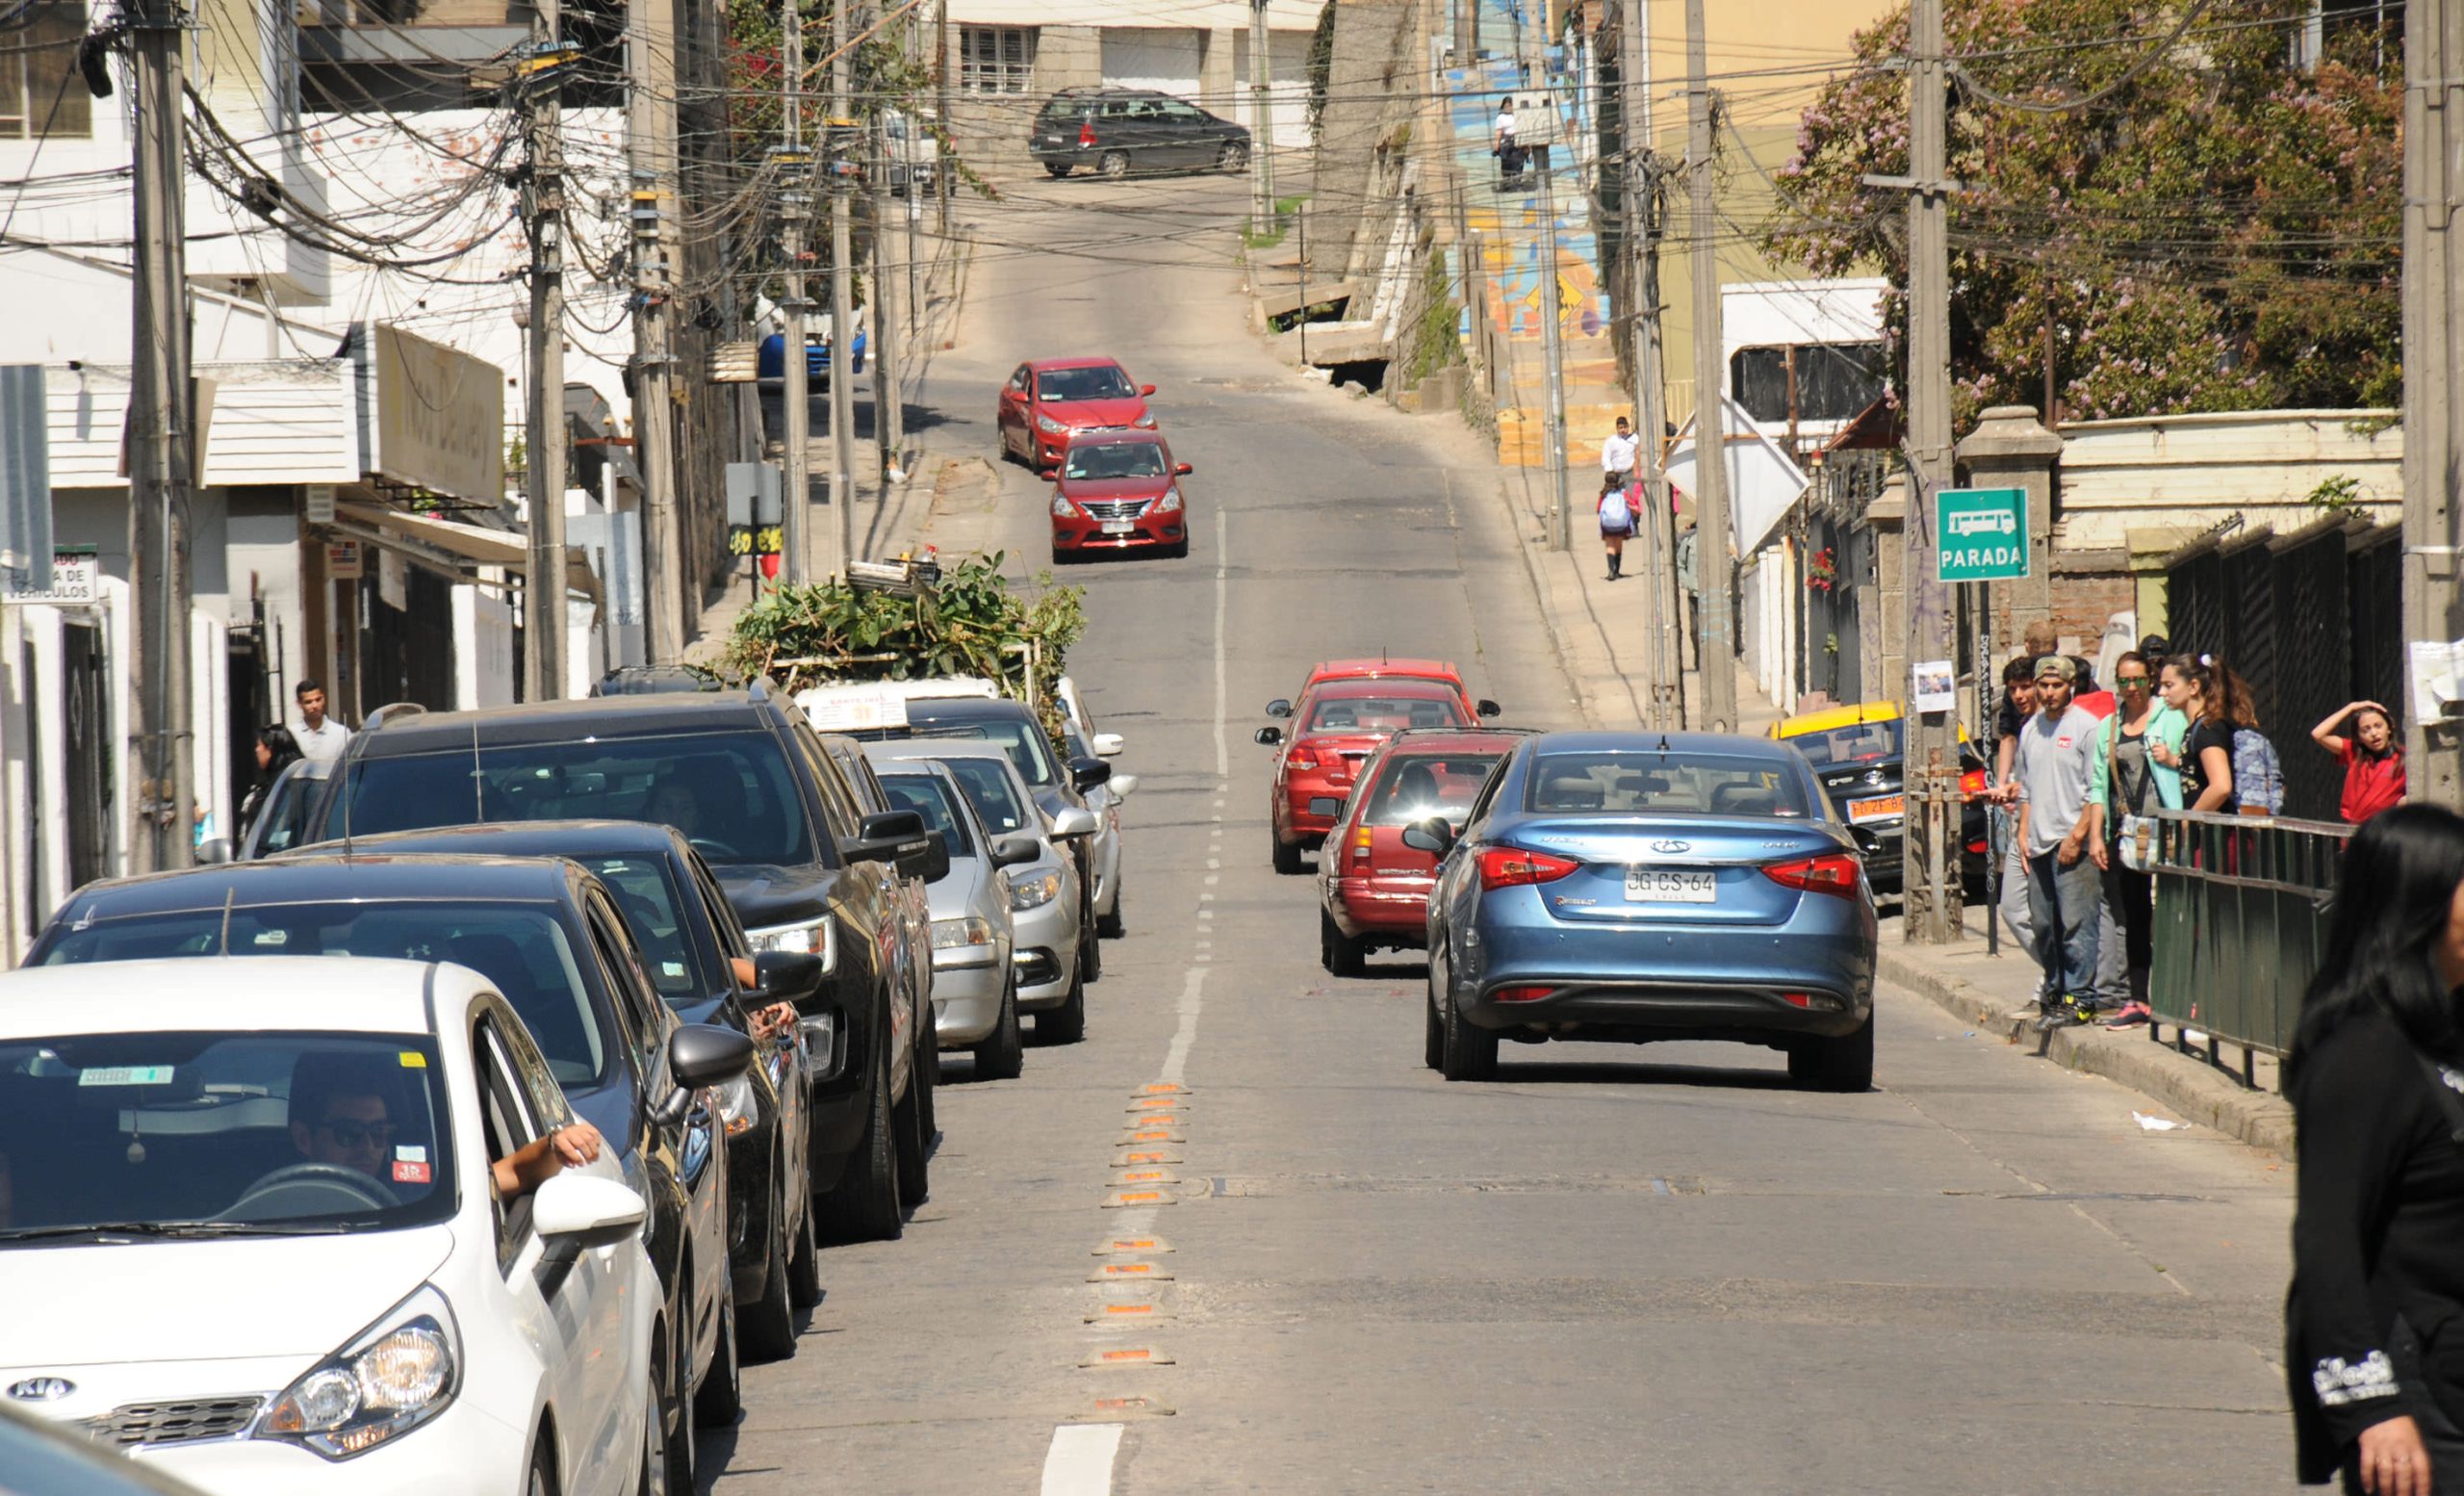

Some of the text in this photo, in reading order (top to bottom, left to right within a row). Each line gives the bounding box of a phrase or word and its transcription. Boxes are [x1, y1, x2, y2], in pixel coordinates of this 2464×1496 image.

[1940, 546, 2022, 568] PARADA
[66, 570, 85, 582] DE
[15, 1378, 66, 1396] KIA
